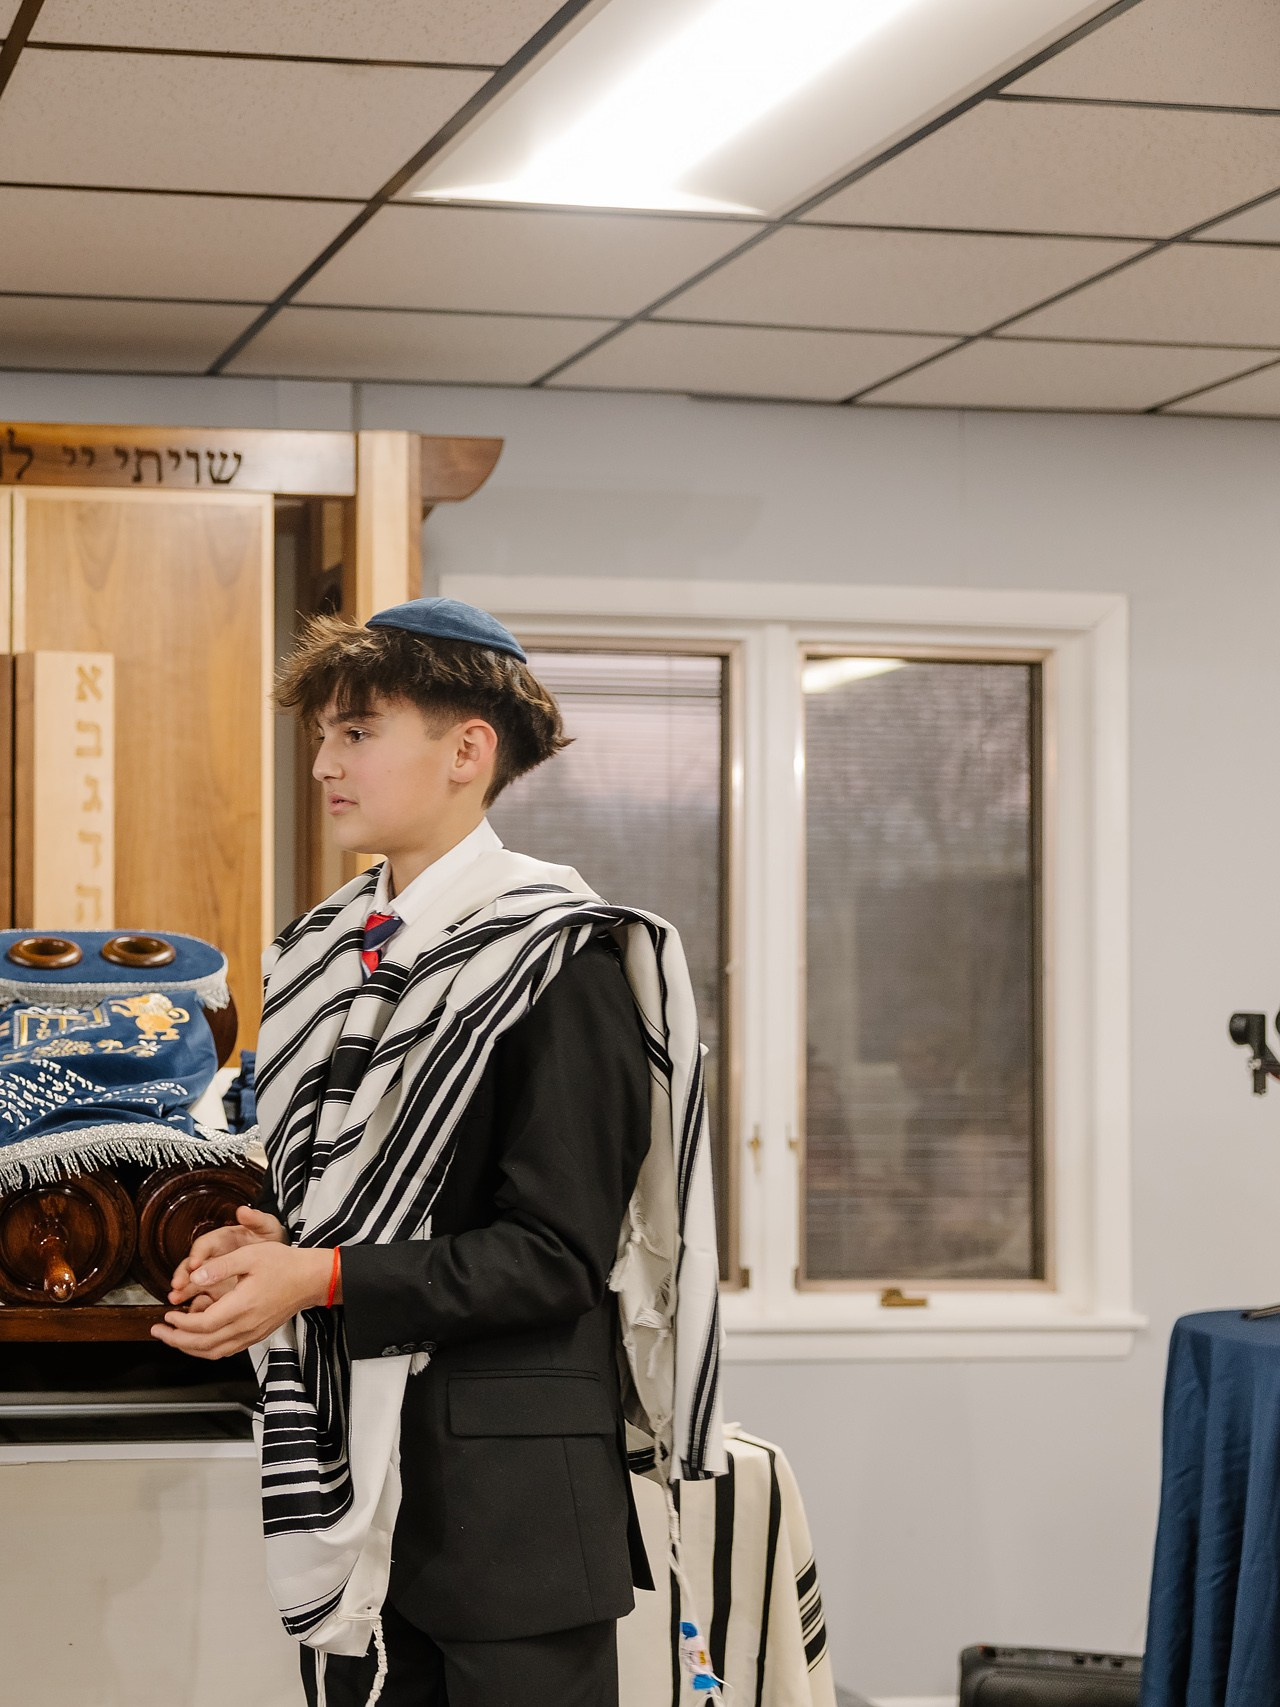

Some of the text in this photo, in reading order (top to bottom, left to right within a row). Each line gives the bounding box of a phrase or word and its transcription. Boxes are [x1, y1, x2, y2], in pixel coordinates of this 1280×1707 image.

[62, 446, 95, 468] יי
[115, 445, 243, 485] שויתי
[76, 665, 103, 702] א
[76, 720, 103, 758] ב
[82, 775, 102, 812] ג
[78, 830, 102, 868] ד
[76, 884, 102, 923] ה
